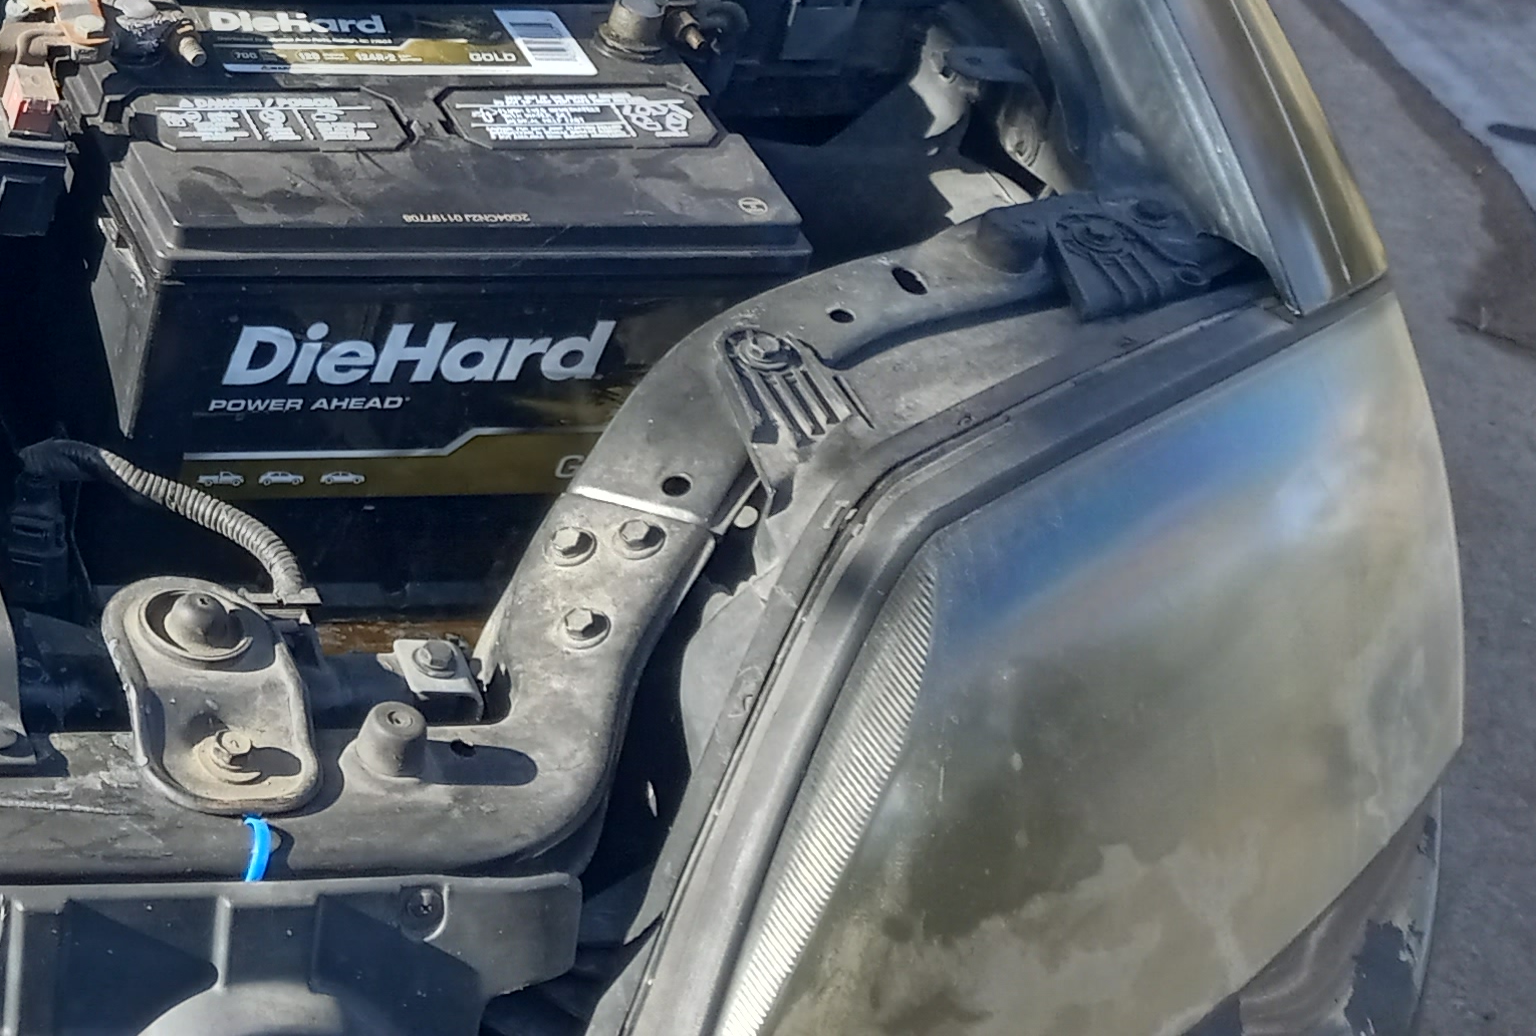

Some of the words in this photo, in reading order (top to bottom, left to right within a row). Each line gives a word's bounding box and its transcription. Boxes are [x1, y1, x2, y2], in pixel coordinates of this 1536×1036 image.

[208, 10, 387, 34] DieHard
[469, 51, 517, 63] GOLD
[221, 319, 617, 385] DieHard
[208, 398, 304, 412] POWER
[310, 396, 403, 411] AHEAD
